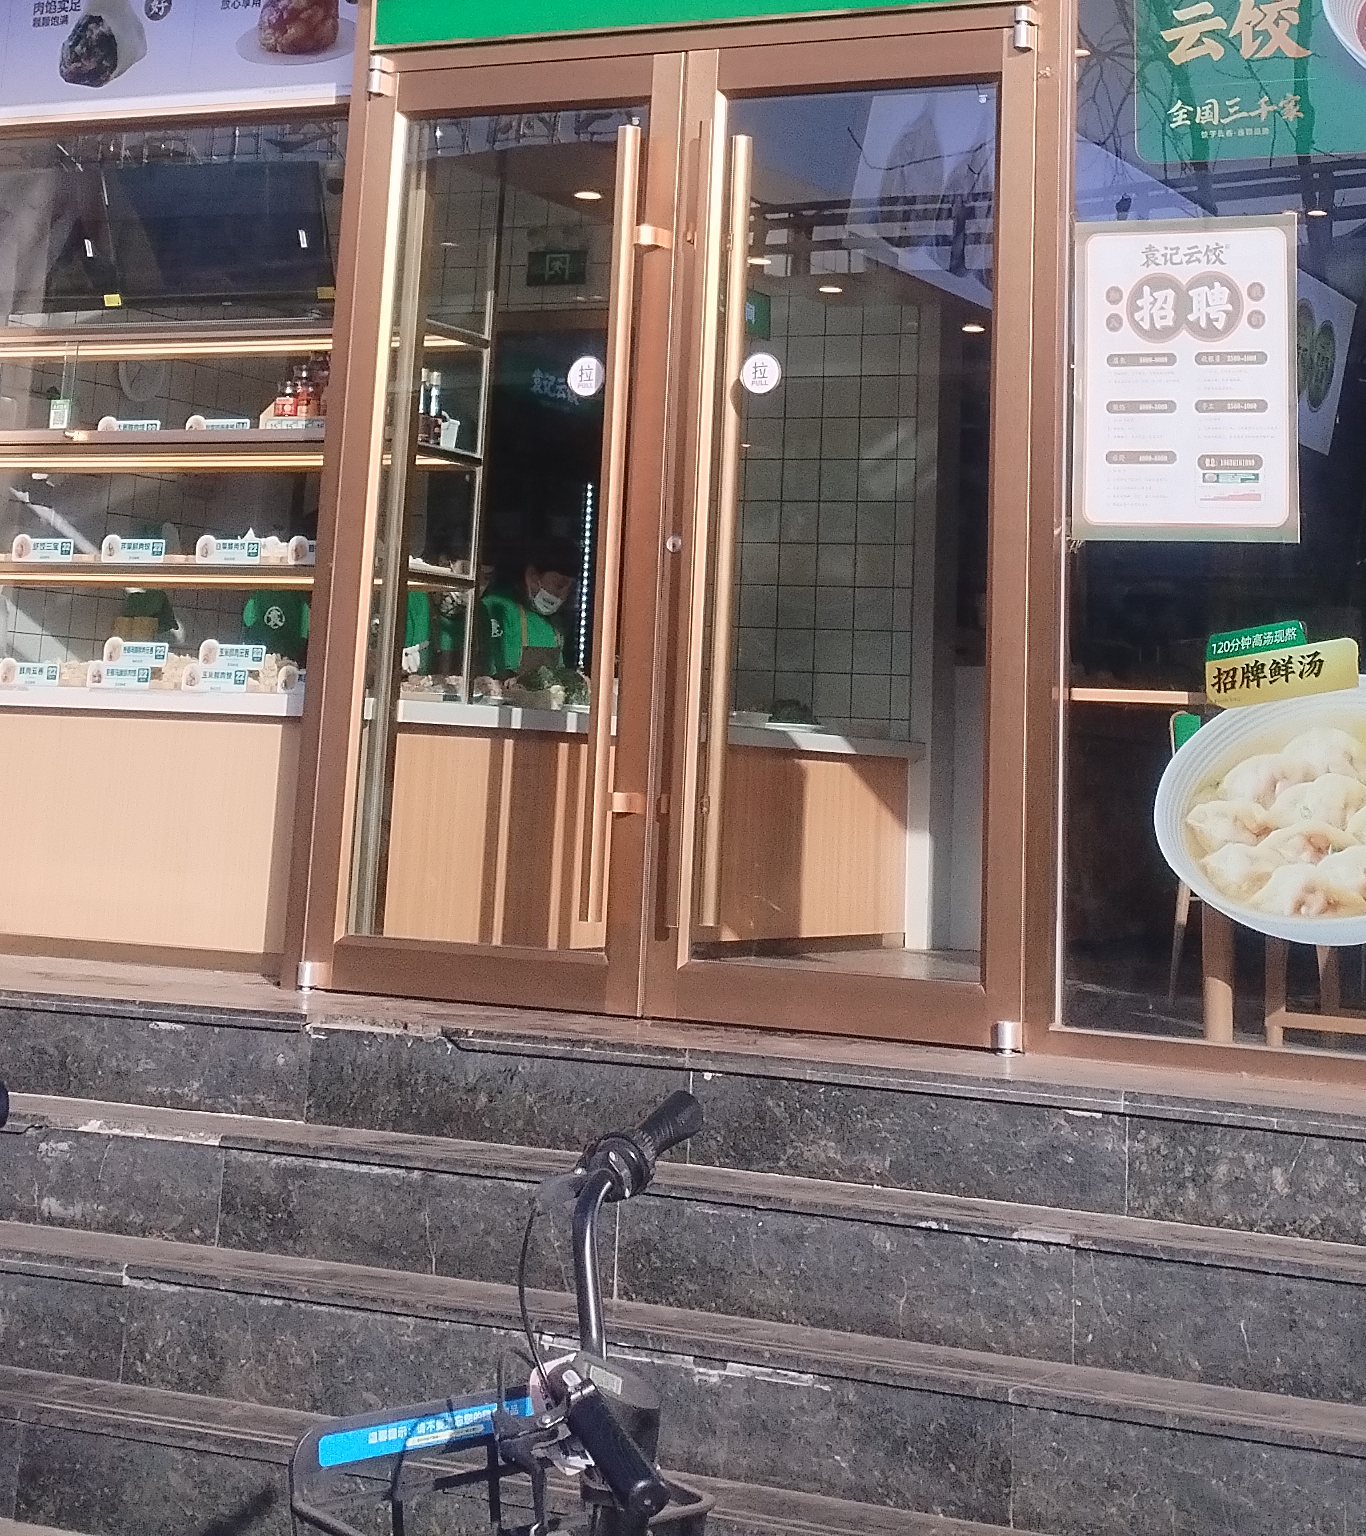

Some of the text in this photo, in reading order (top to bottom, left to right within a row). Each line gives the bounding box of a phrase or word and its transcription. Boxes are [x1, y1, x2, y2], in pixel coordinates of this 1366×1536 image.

[1166, 92, 1305, 130] 全国三千家
[1139, 242, 1228, 268] 袁记云饺
[1133, 281, 1234, 332] 招聘
[578, 363, 594, 382] 拉
[750, 379, 770, 387] PULL
[751, 361, 769, 380] 拉
[1211, 626, 1298, 655] 120分钟高汤现熬
[1210, 650, 1325, 695] 招牌鲜汤
